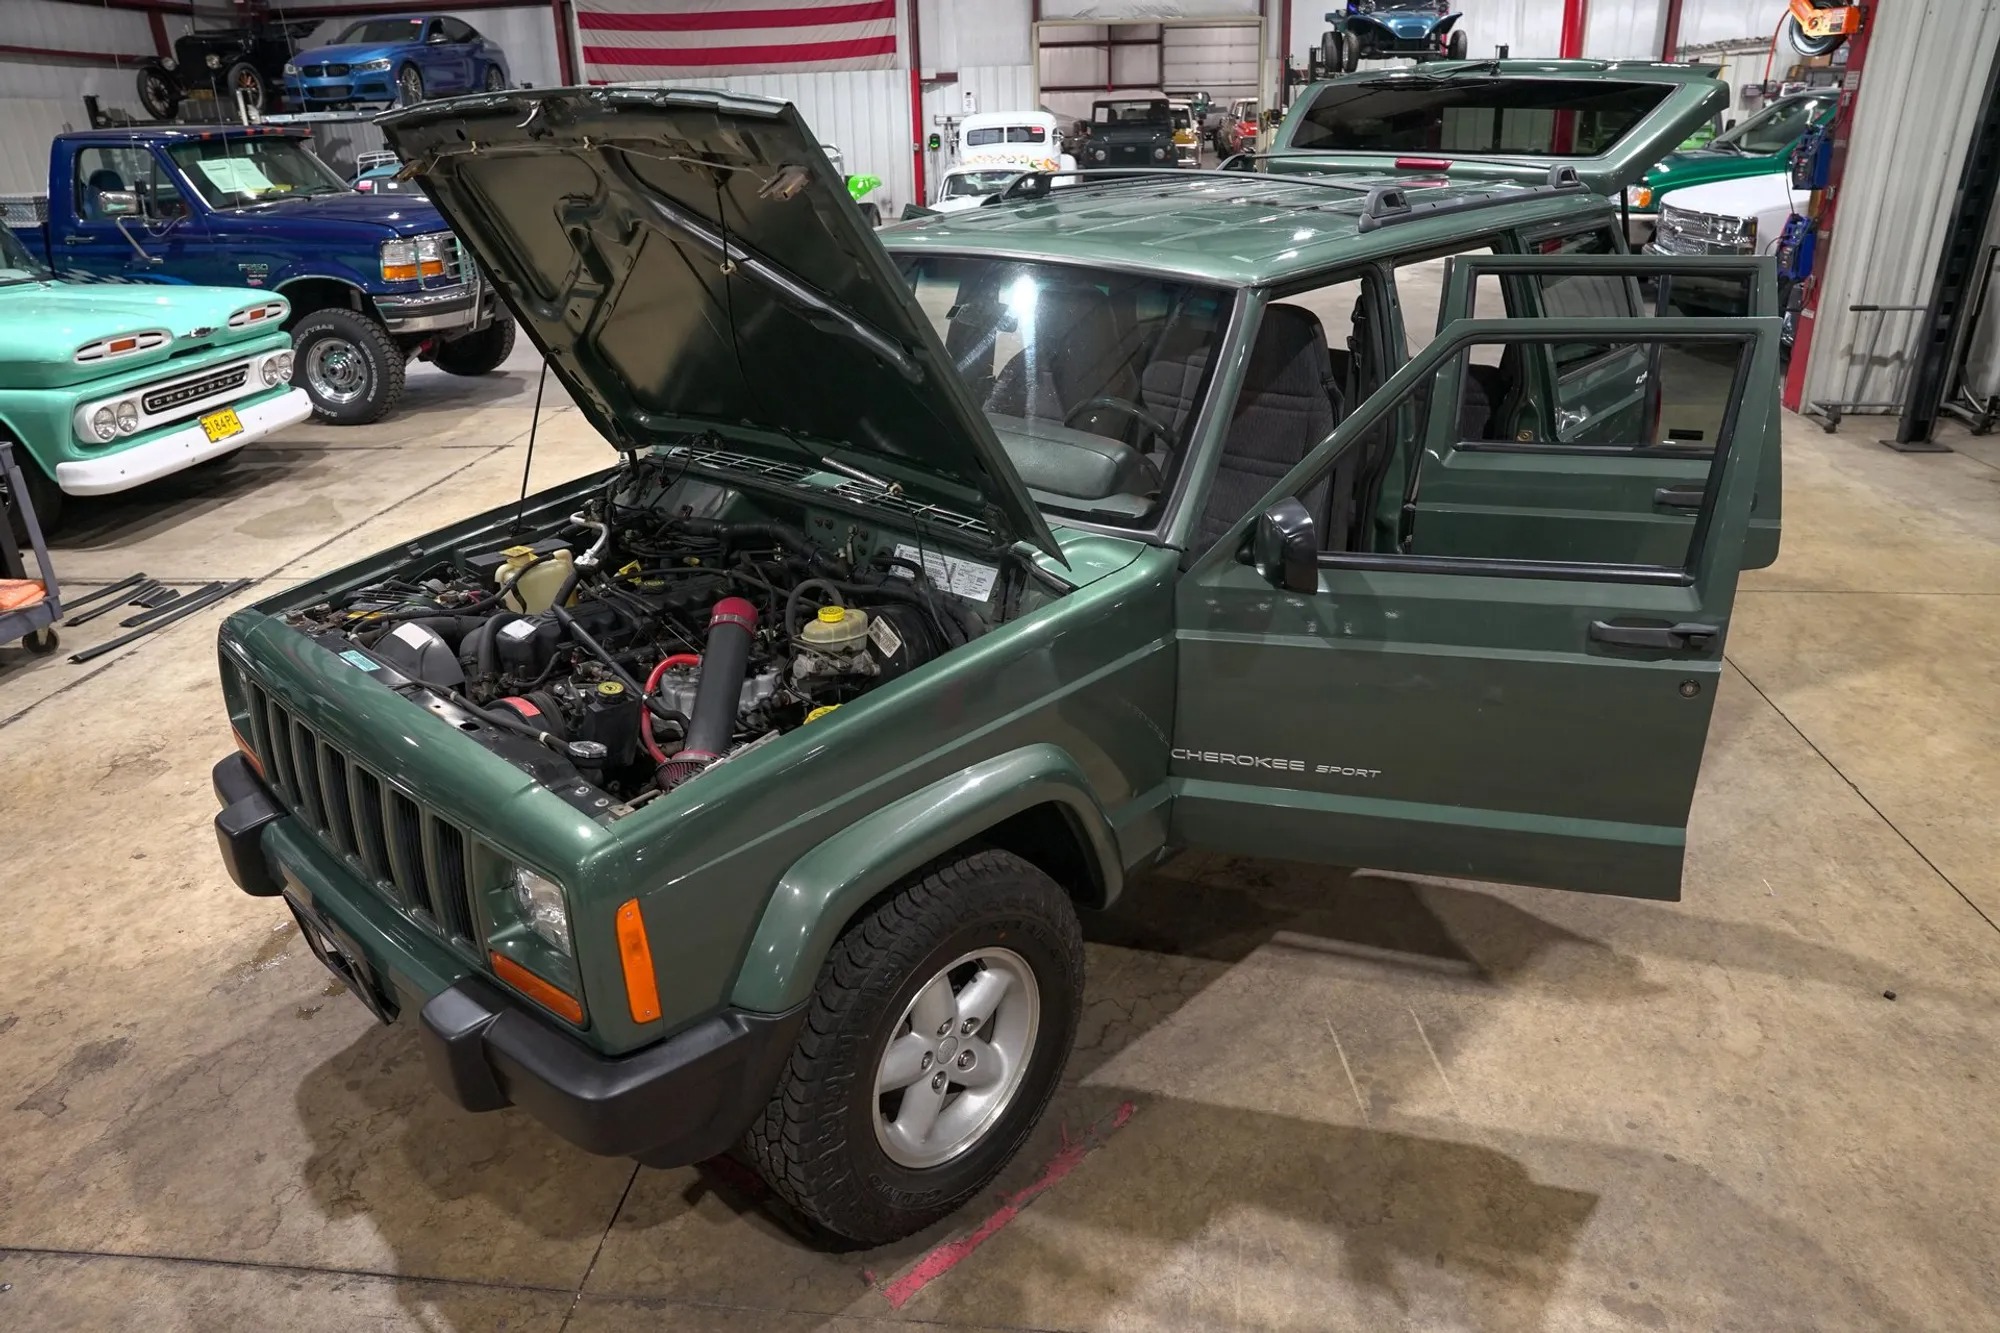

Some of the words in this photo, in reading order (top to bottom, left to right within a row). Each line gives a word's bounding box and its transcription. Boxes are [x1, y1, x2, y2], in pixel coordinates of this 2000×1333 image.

[154, 375, 241, 405] CHEVROLET
[1171, 748, 1305, 771] CHEROKEE
[1315, 764, 1382, 778] SPORT
